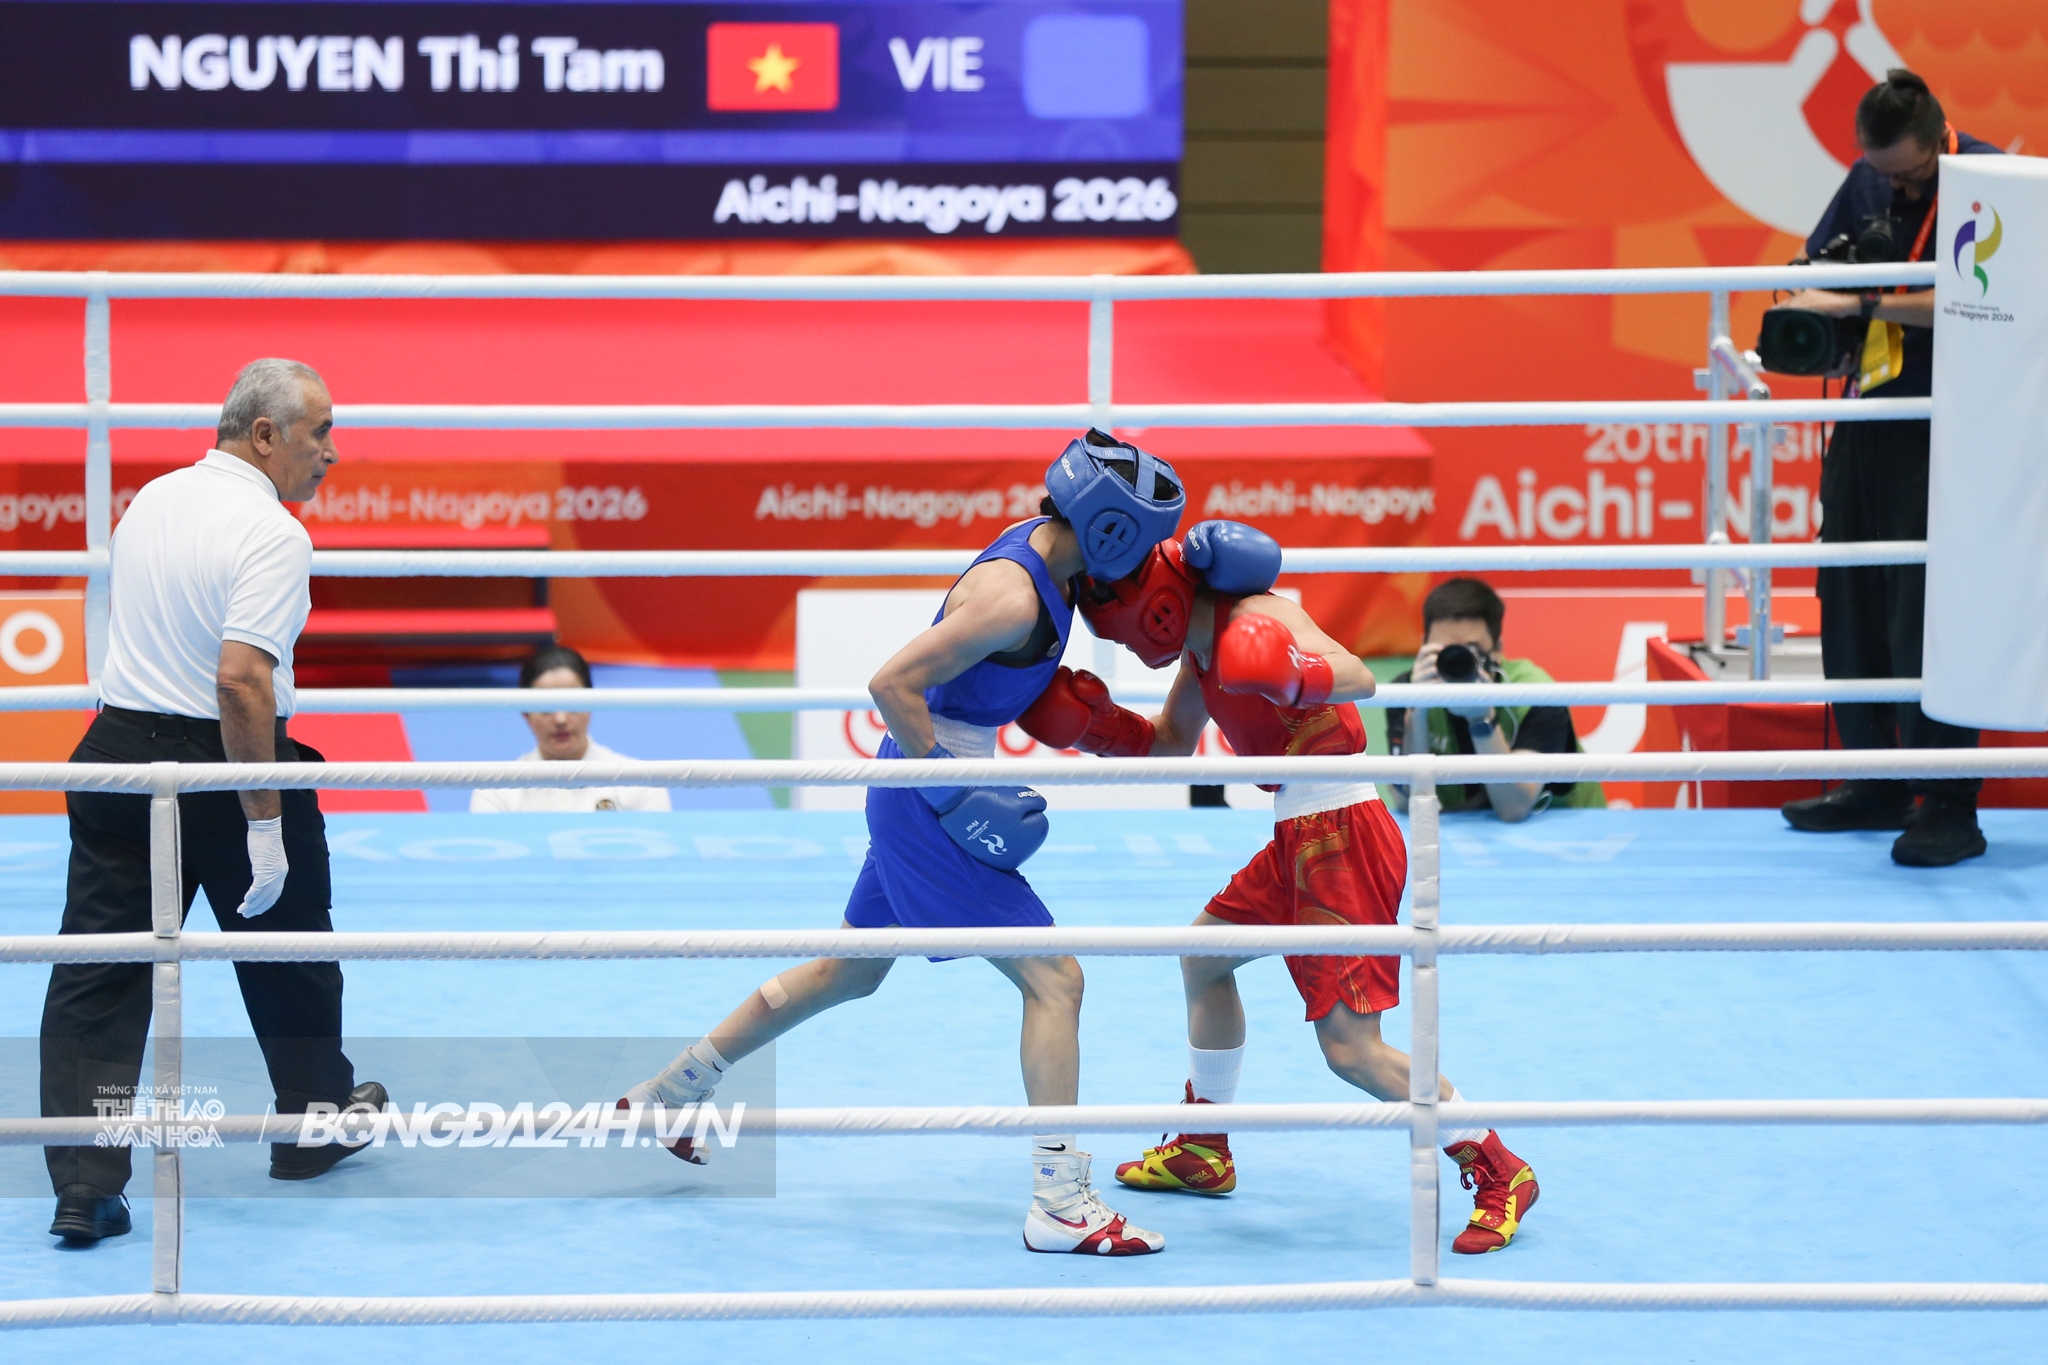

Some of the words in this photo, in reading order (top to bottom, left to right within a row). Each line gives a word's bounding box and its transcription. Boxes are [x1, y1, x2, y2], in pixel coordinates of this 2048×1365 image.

[130, 34, 404, 91] NGUYEN
[419, 33, 519, 91] Thi
[532, 37, 665, 91] Tam
[888, 37, 985, 91] VIE
[714, 174, 1046, 233] Aichi-Nagoya
[1052, 177, 1178, 222] 2026
[301, 484, 549, 529] Aichi-Nagoya
[555, 486, 648, 521] 2026
[755, 483, 1003, 528] Aichi-Nagoya
[1006, 483, 1047, 517] 20
[1186, 1170, 1208, 1183] CHINA
